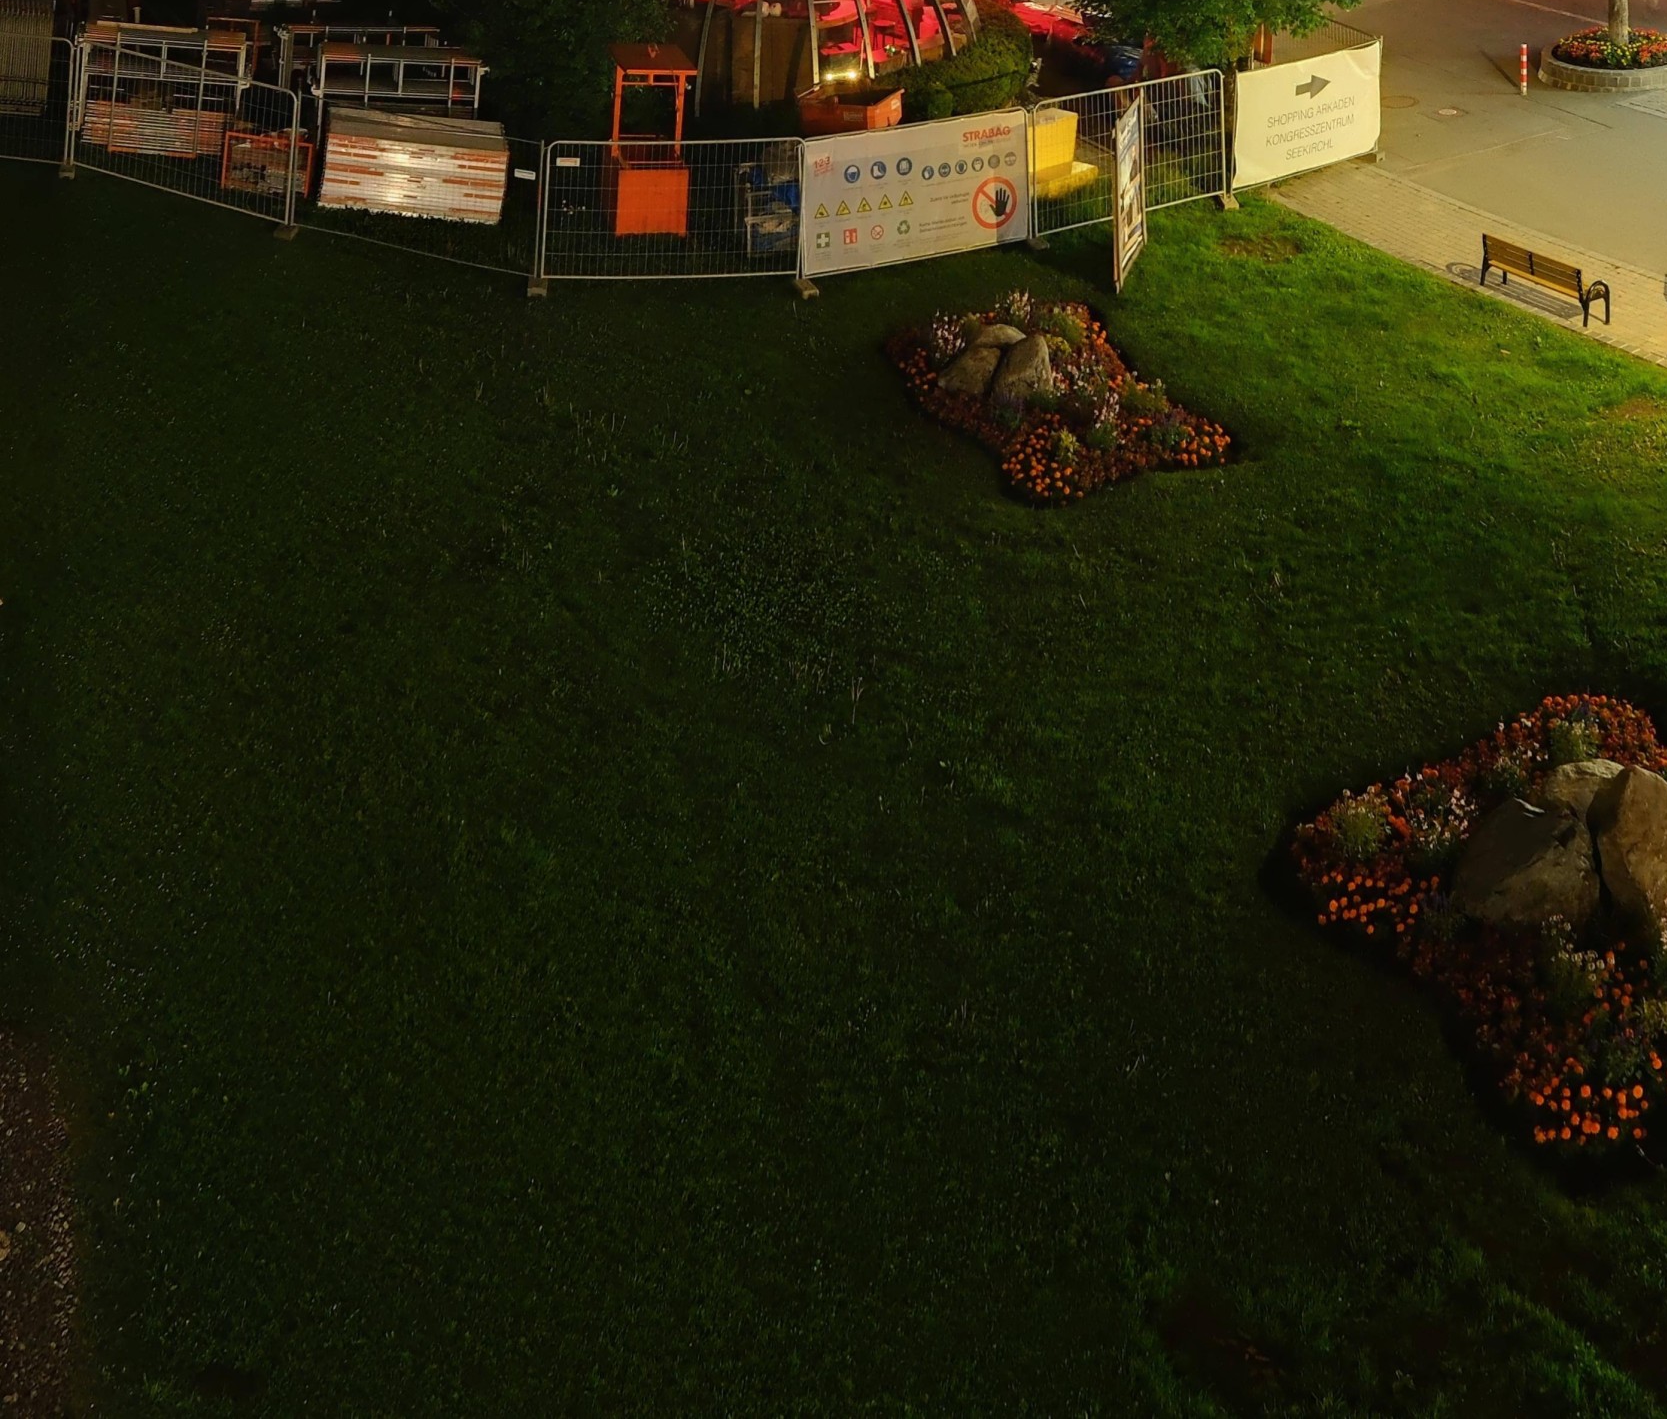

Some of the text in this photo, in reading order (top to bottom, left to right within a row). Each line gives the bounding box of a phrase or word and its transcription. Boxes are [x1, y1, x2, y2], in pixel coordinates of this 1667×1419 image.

[1266, 95, 1355, 129] SHOPPING ARKADEN
[962, 125, 1011, 143] STRABAG
[1265, 114, 1355, 147] KONGRESSZENTRUM
[1285, 139, 1334, 161] SEEKIRCHL
